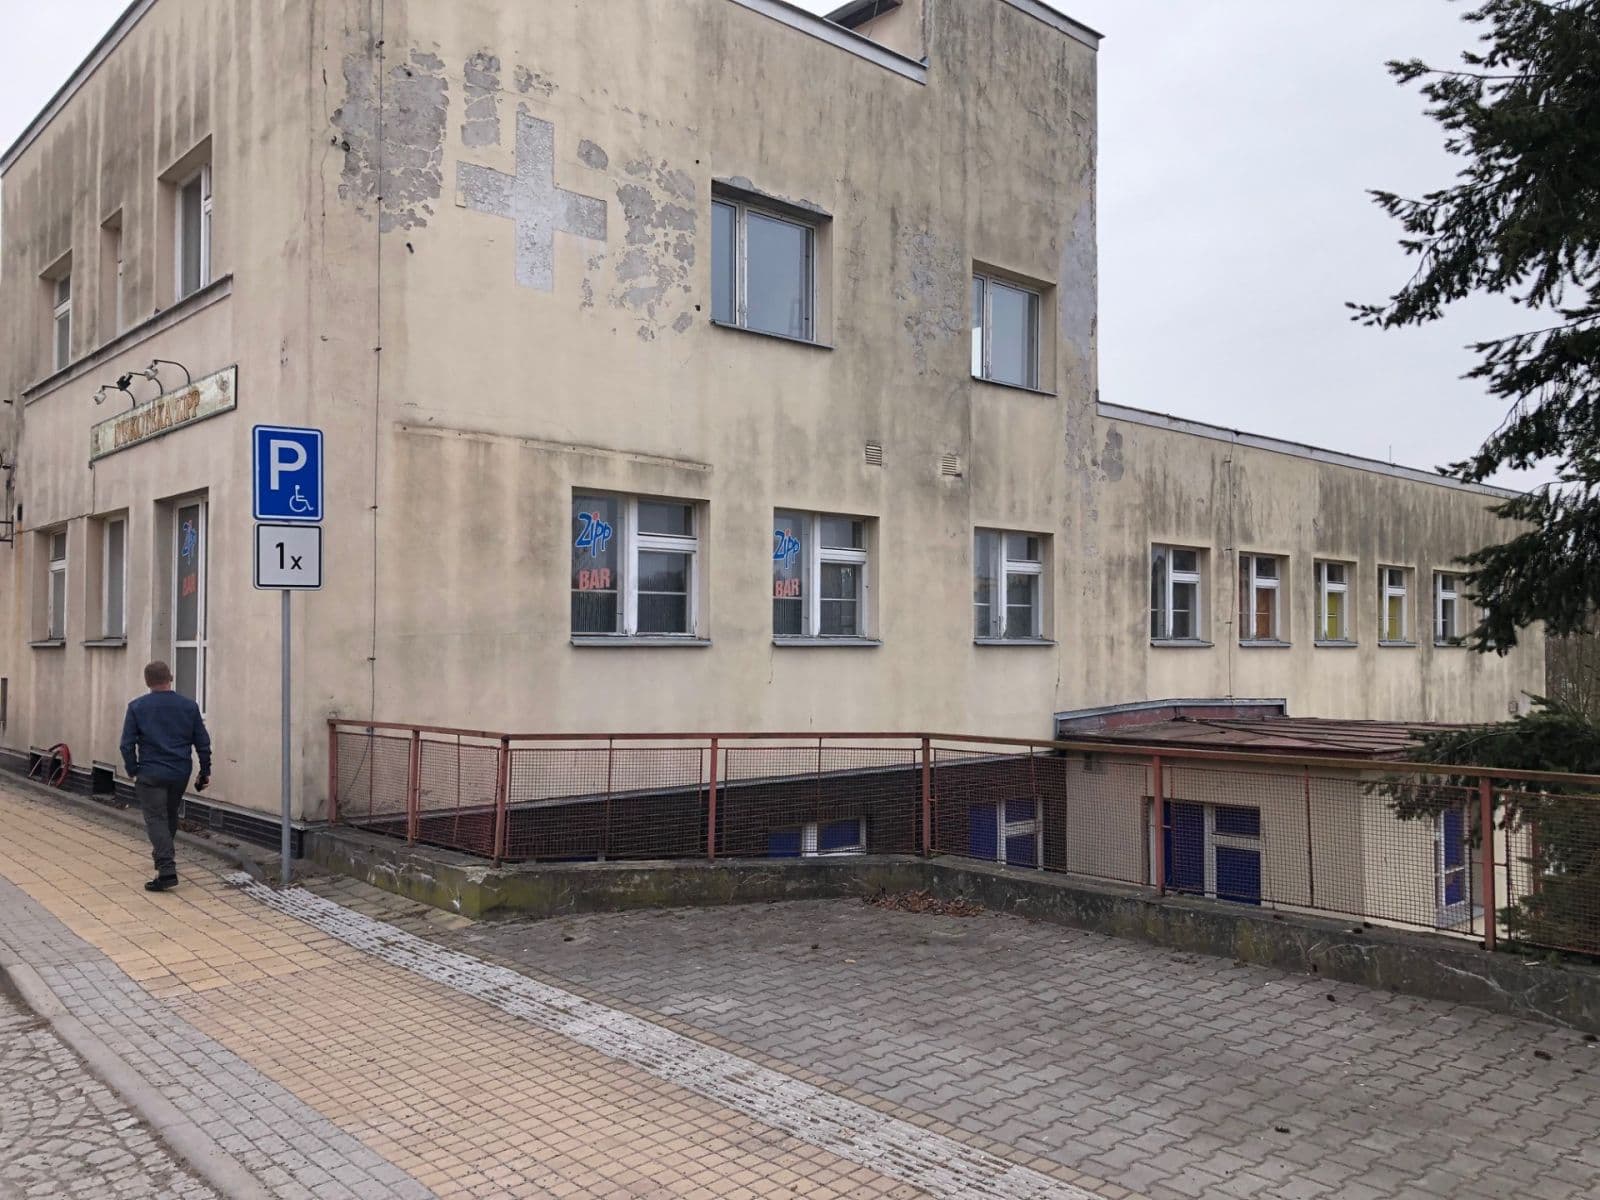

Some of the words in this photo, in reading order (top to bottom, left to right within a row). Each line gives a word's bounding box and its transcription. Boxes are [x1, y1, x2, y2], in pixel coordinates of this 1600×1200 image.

[270, 439, 307, 490] P
[575, 511, 613, 558] Zipp
[772, 528, 800, 570] Zipp
[579, 567, 611, 590] BAR
[775, 578, 800, 597] BAR
